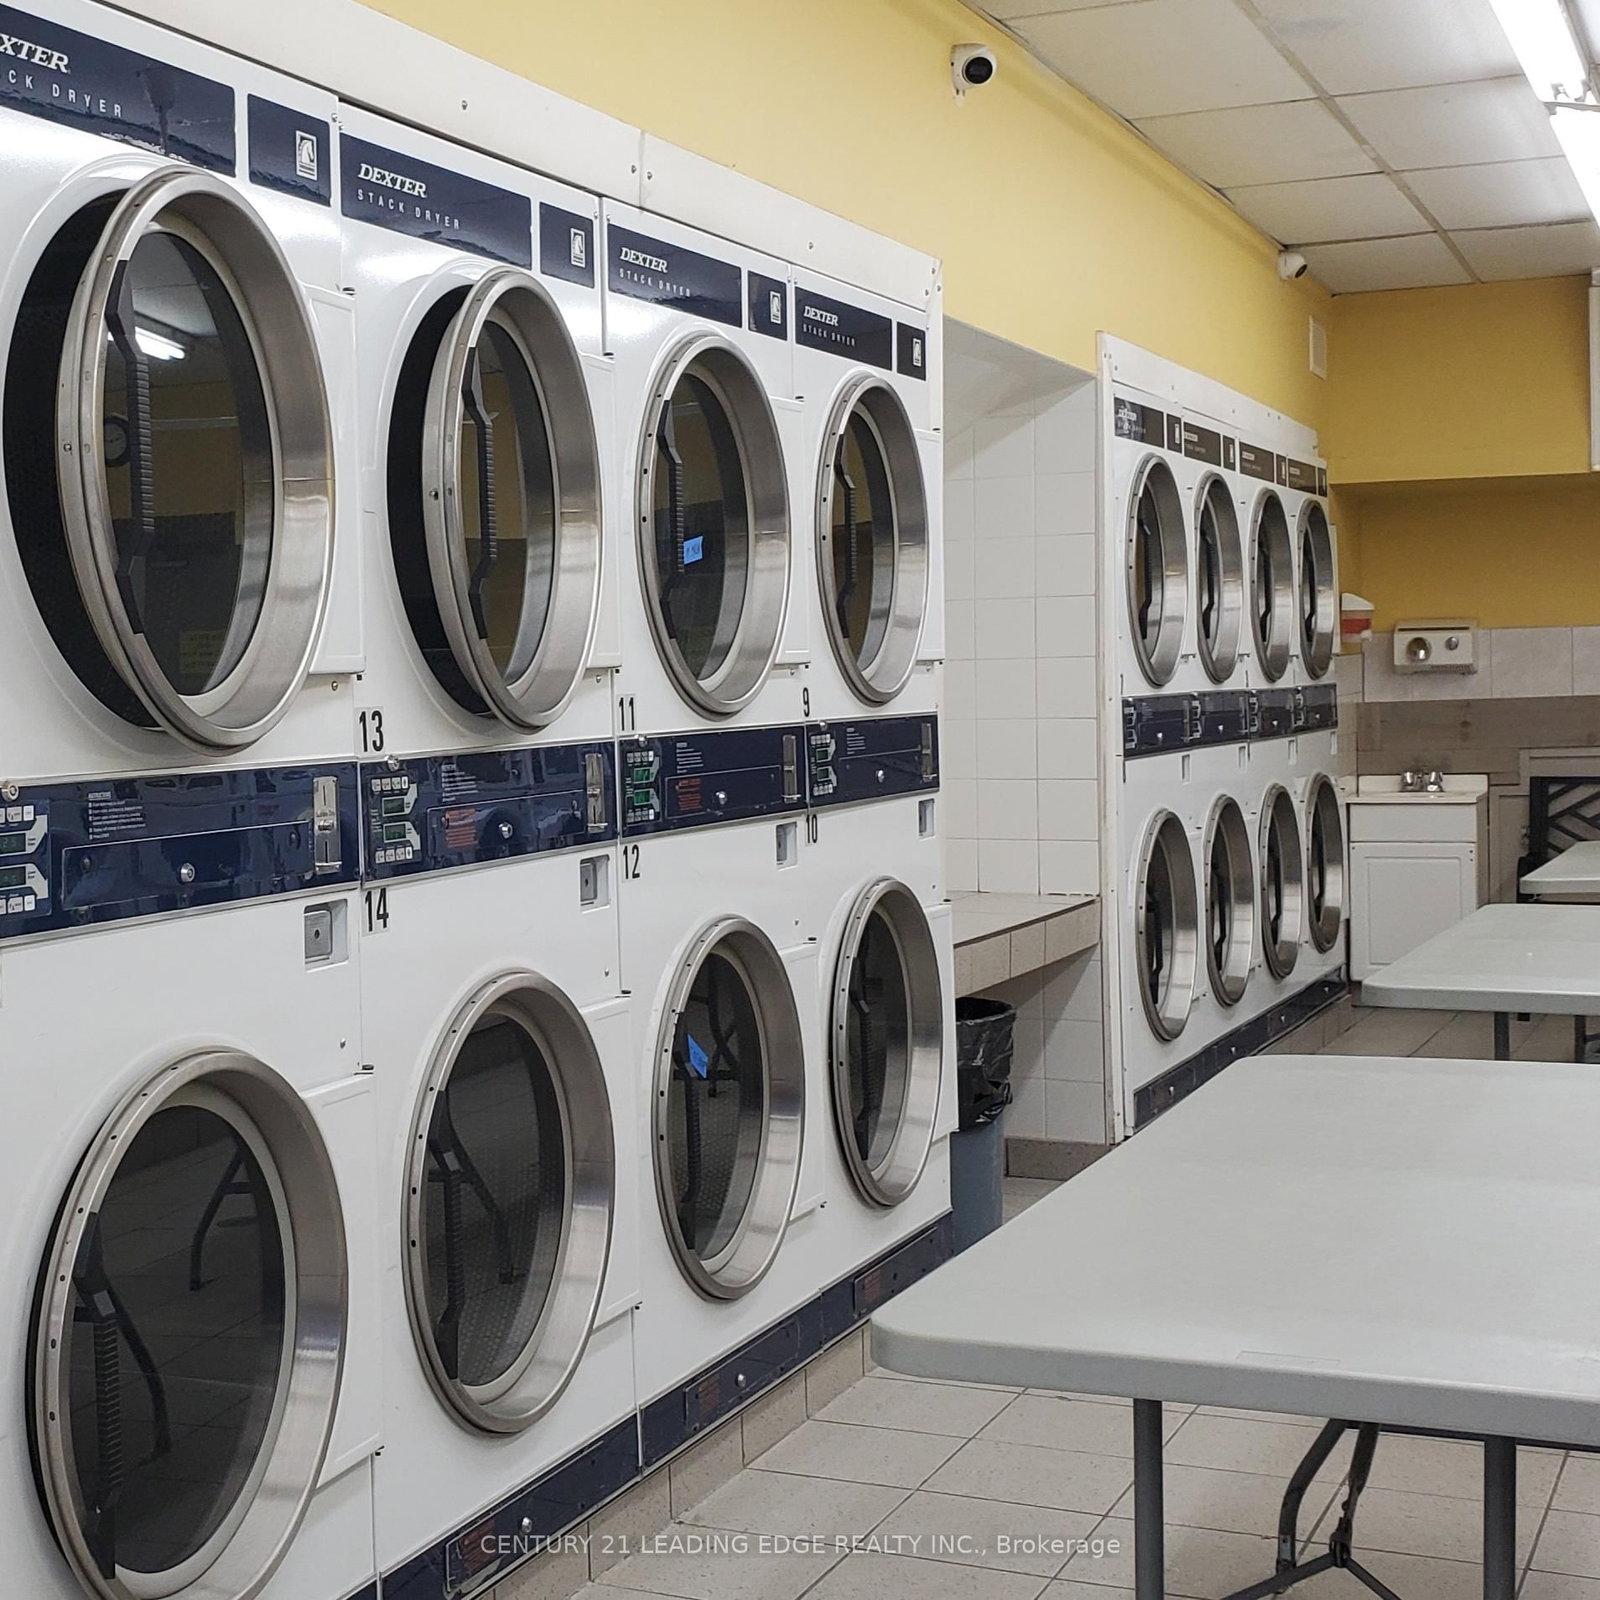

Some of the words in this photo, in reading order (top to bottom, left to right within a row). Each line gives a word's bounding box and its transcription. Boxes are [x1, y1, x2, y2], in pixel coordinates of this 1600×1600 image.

[52, 83, 122, 119] DRYER
[357, 163, 427, 198] DEXTER
[357, 188, 405, 213] STACK
[415, 206, 460, 230] DRYER
[619, 247, 668, 273] DEXTER
[619, 267, 652, 286] STACK
[659, 280, 691, 297] DRYER
[803, 305, 839, 327] DEXTER
[618, 697, 635, 731] 11
[802, 686, 811, 718] 9
[359, 710, 384, 753] 13
[805, 813, 818, 844] 10
[622, 844, 641, 880] 12
[364, 887, 390, 933] 14
